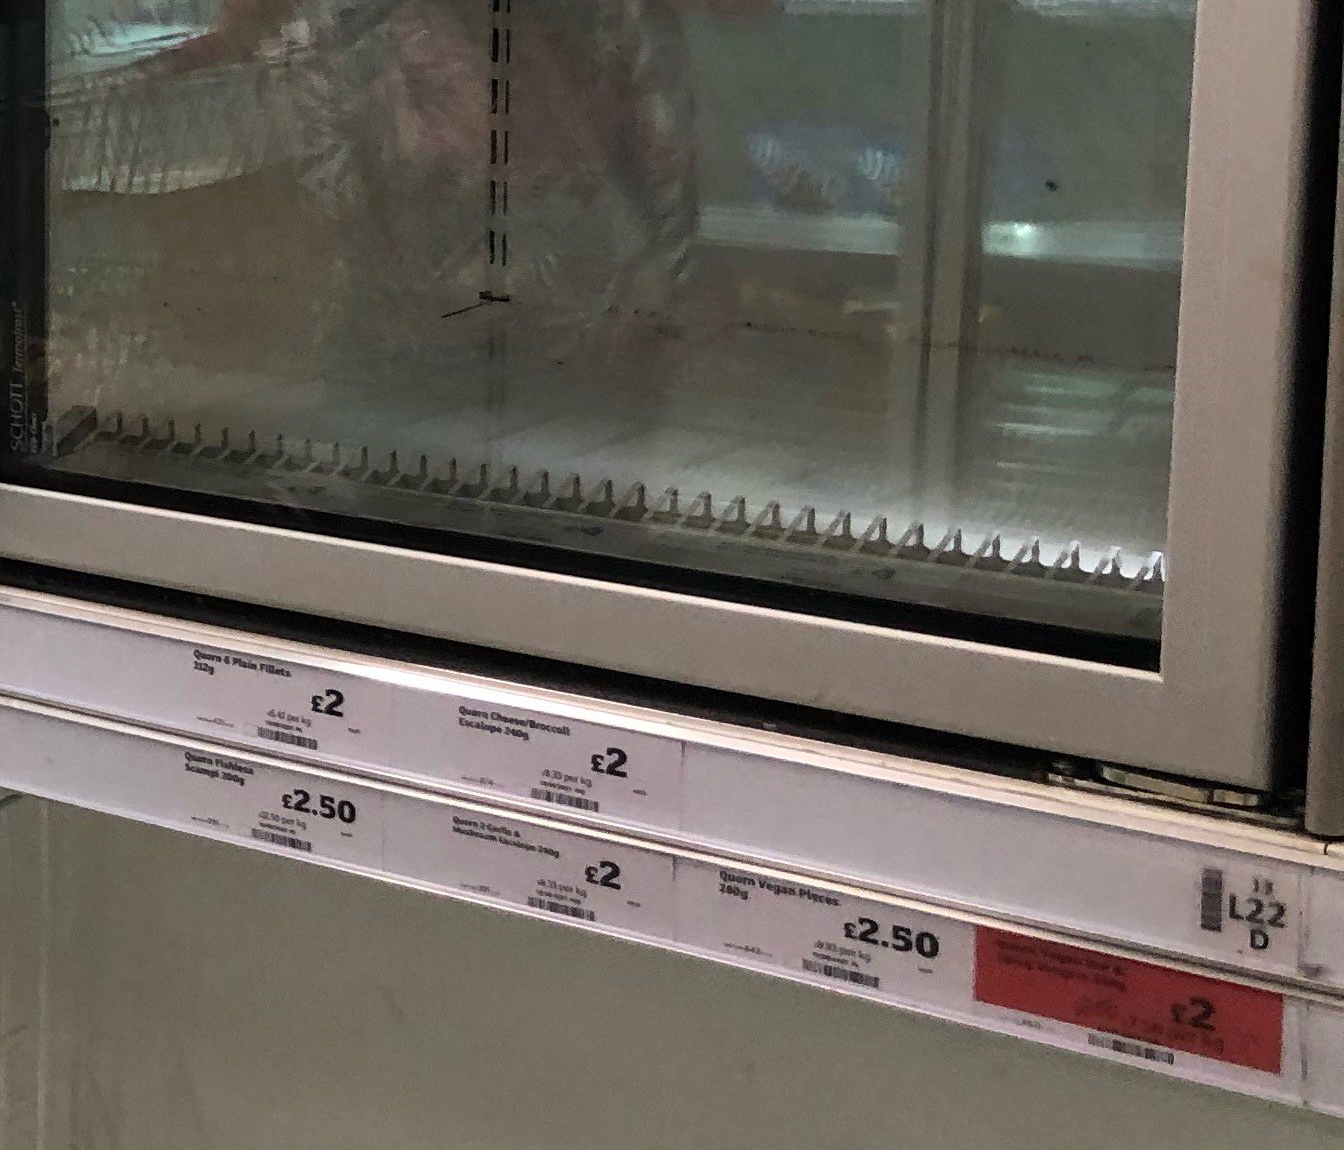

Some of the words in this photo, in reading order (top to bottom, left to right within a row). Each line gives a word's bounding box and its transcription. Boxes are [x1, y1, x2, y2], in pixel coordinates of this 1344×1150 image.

[193, 649, 222, 664] Quorn
[231, 657, 257, 671] Plain
[259, 662, 293, 678] Fillets
[310, 688, 346, 718] £2
[286, 713, 300, 724] per
[301, 716, 312, 727] kg
[458, 705, 489, 720] Quorn
[490, 711, 571, 737] Cheese/Broccoli
[458, 717, 503, 735] Escalope
[184, 751, 213, 765] Quorn
[214, 758, 254, 775] Fishless
[590, 746, 628, 779] £2
[563, 772, 579, 784] per
[580, 777, 593, 788] kg
[281, 788, 356, 824] £2.50
[452, 815, 478, 827] Quorn
[282, 815, 295, 826] per
[296, 818, 307, 830] kg
[584, 860, 621, 890] £2
[719, 870, 755, 887] Quorn
[759, 877, 796, 896] Vegan
[798, 887, 841, 907] Pieces
[1228, 892, 1287, 929] L22
[843, 916, 940, 959] £2.50
[1250, 929, 1269, 950] D
[1170, 996, 1216, 1031] £2
